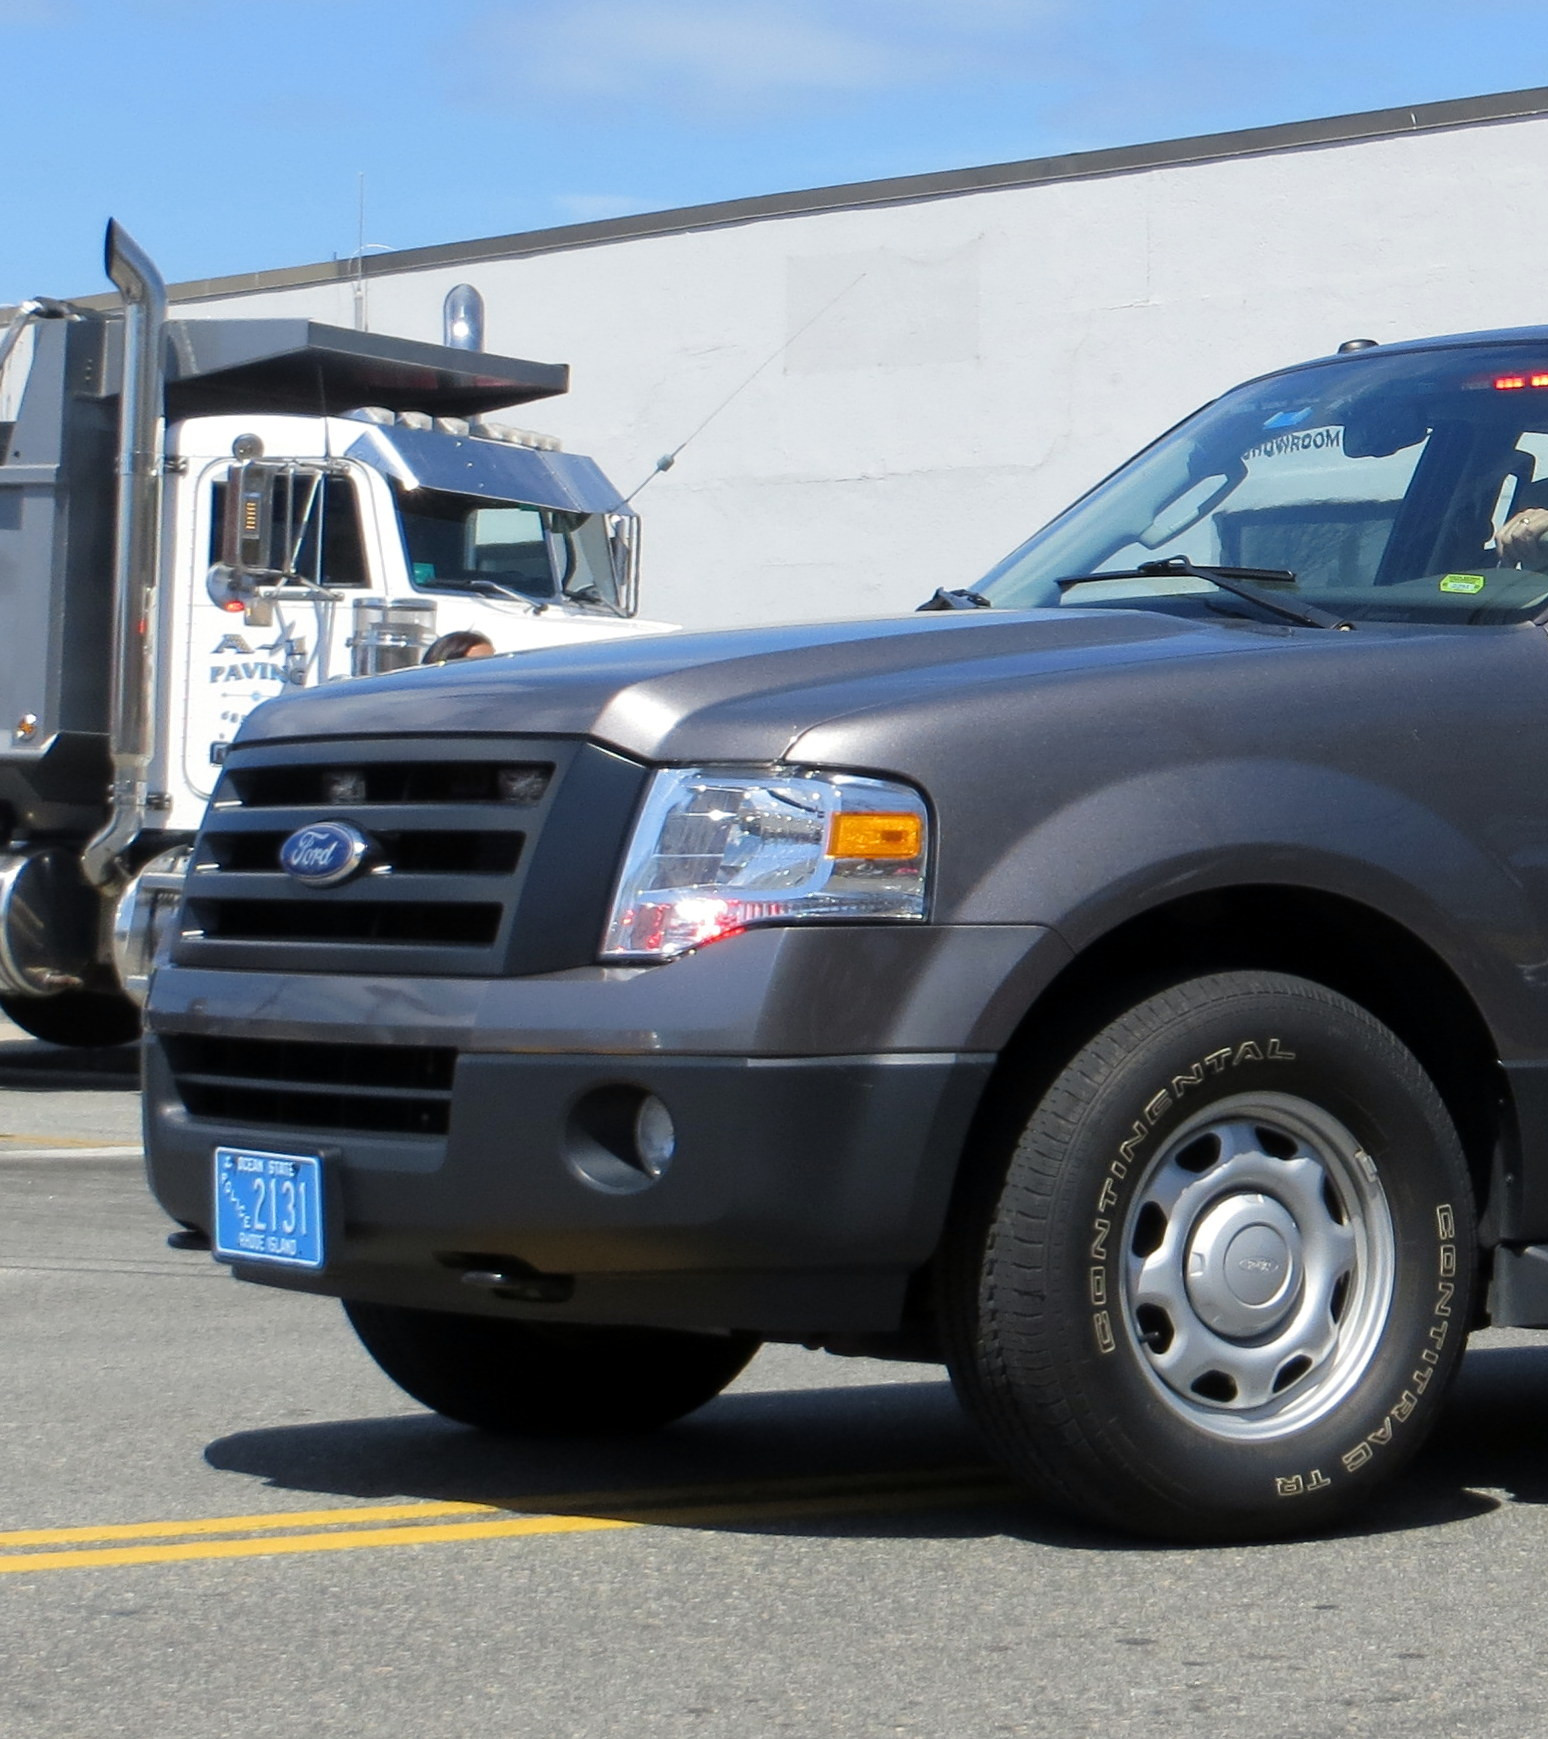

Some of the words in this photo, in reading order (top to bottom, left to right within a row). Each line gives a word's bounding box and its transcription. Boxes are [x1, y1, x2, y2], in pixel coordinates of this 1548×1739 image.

[209, 661, 307, 687] PAVING
[291, 830, 340, 866] Ford
[253, 1177, 308, 1236] 2131
[1091, 1037, 1297, 1354] CONTINENTAL
[1341, 1203, 1457, 1473] CONTITRAC
[1275, 1468, 1331, 1497] TR
